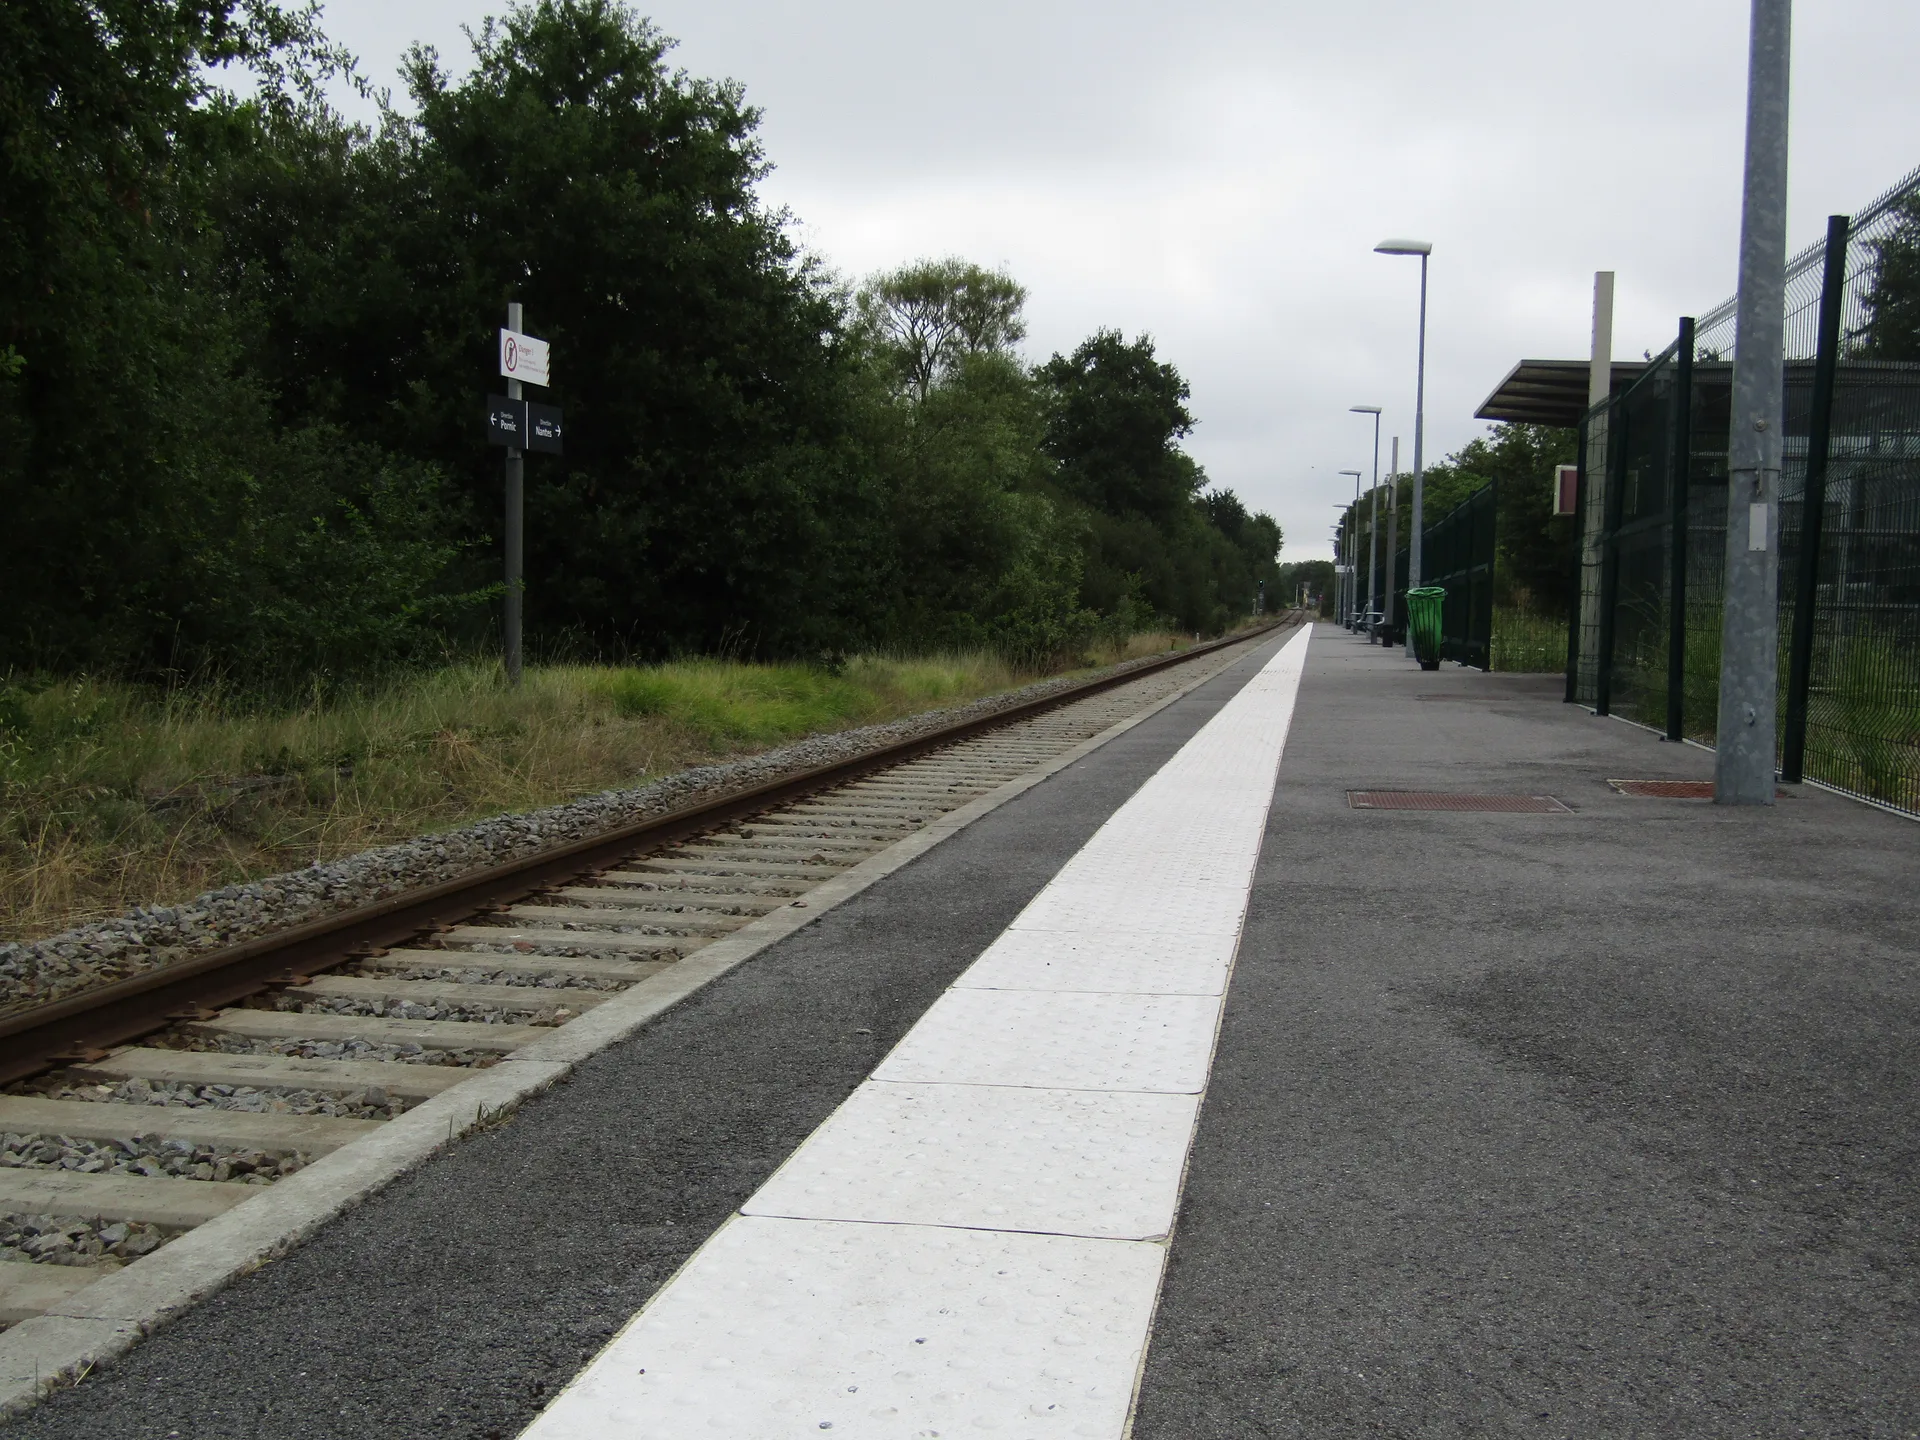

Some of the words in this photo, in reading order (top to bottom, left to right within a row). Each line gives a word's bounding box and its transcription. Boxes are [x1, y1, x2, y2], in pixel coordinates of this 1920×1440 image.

[518, 344, 531, 356] Danger
[500, 419, 516, 431] Pornic
[535, 425, 552, 438] Nantes
